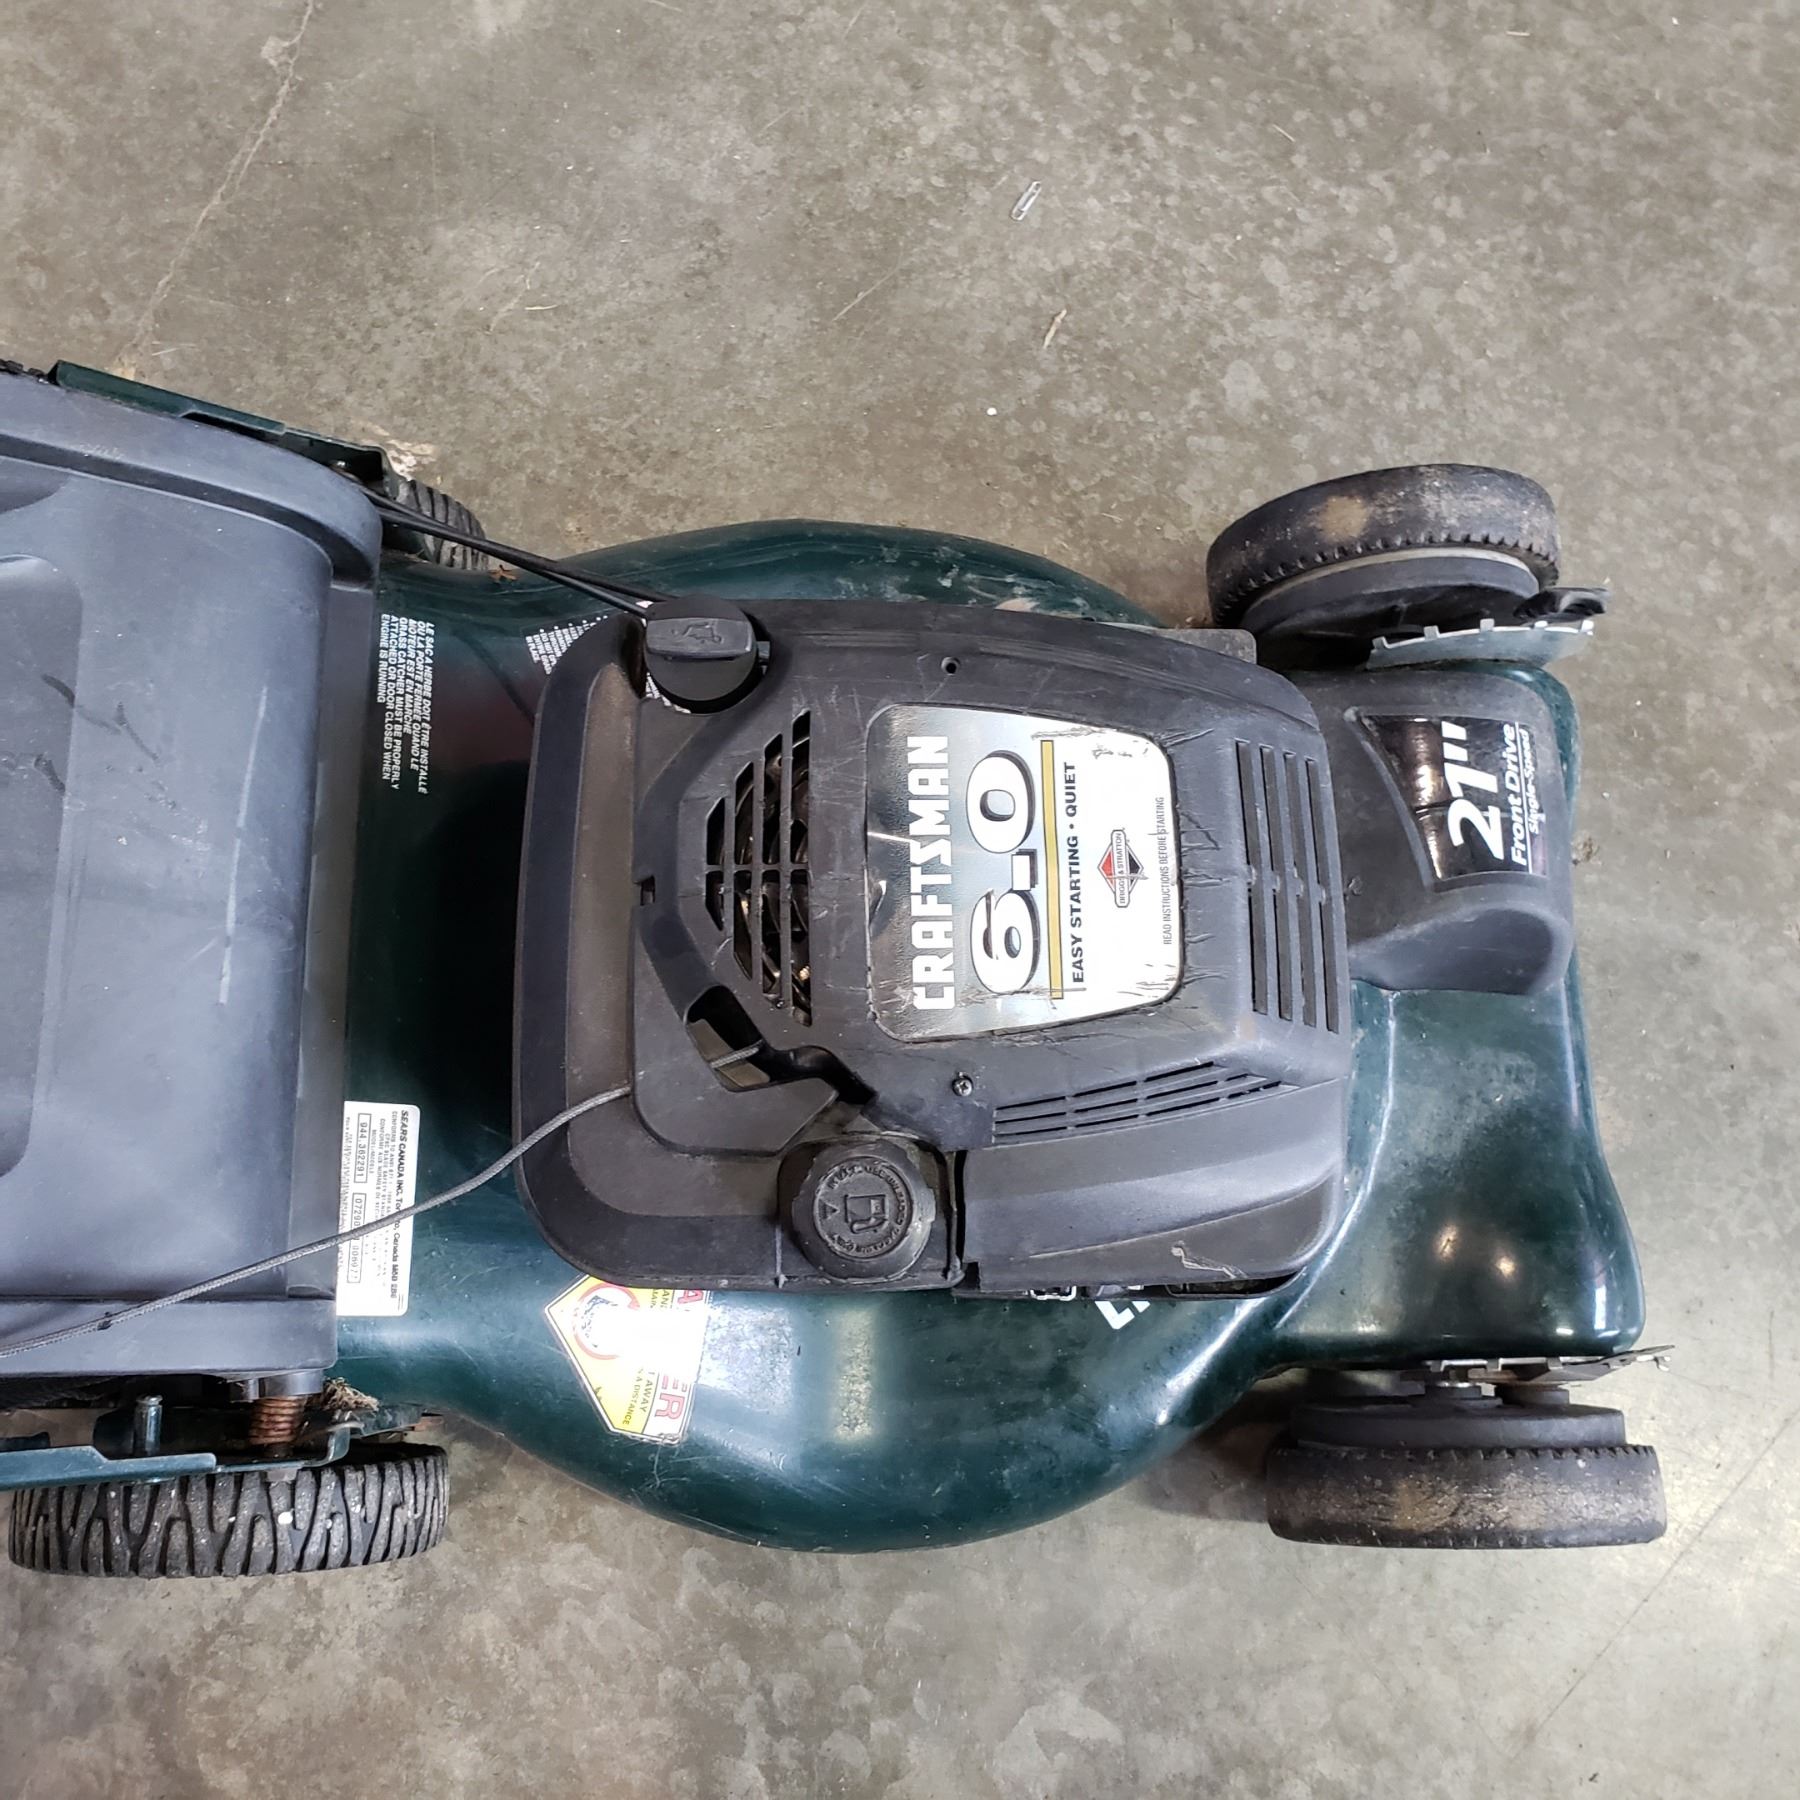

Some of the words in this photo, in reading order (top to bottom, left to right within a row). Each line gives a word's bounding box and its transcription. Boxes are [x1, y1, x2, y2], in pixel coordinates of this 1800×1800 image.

[380, 613, 389, 647] ENGINE
[388, 615, 398, 664] ATTACHED
[397, 617, 407, 648] GRASS
[406, 619, 416, 657] MOTEUR
[416, 620, 425, 636] OU
[416, 636, 424, 648] LA
[425, 622, 434, 634] LE
[379, 649, 387, 658] IS
[424, 636, 433, 655] SAC
[377, 660, 386, 702] RUNNING
[387, 666, 395, 679] OR
[395, 650, 405, 694] CATCHER
[405, 659, 414, 677] EST
[414, 650, 424, 681] PORTE
[422, 665, 432, 697] HERBE
[385, 681, 394, 708] DOOR
[405, 679, 413, 692] EN
[412, 683, 423, 720] FERMÉE
[394, 696, 403, 722] MUST
[402, 693, 412, 733] MARCHE
[421, 698, 430, 721] DOIT
[383, 711, 393, 749] CLOSED
[393, 724, 401, 736] BE
[410, 722, 420, 756] QUAND
[420, 722, 431, 747] ÊTRE
[382, 751, 391, 779] WHEN
[391, 739, 400, 789] PROPERLY
[410, 758, 418, 770] LE
[418, 748, 429, 793] INSTALLÉ
[1501, 724, 1519, 792] Drive
[1063, 761, 1077, 817] QUIET
[1519, 729, 1540, 834] Single-Speed
[1155, 796, 1166, 833] STARTING
[1508, 793, 1527, 865] Front
[1115, 833, 1123, 868] STRATTON
[1157, 836, 1167, 863] BEFORE
[907, 736, 956, 1009] CRAFTSMAN
[966, 750, 1040, 994] 6.0
[1066, 835, 1082, 927] STARTING
[1159, 866, 1171, 921] INSTRUCTIONS
[1162, 924, 1171, 944] READ
[1070, 933, 1084, 982] EASY
[399, 1110, 408, 1141] SEARS
[356, 1122, 367, 1176] 944.362291
[397, 1143, 405, 1178] CANADA
[392, 1232, 400, 1261] Canada
[623, 1384, 640, 1425] DISTANCE
[640, 1380, 653, 1412] AWAY
